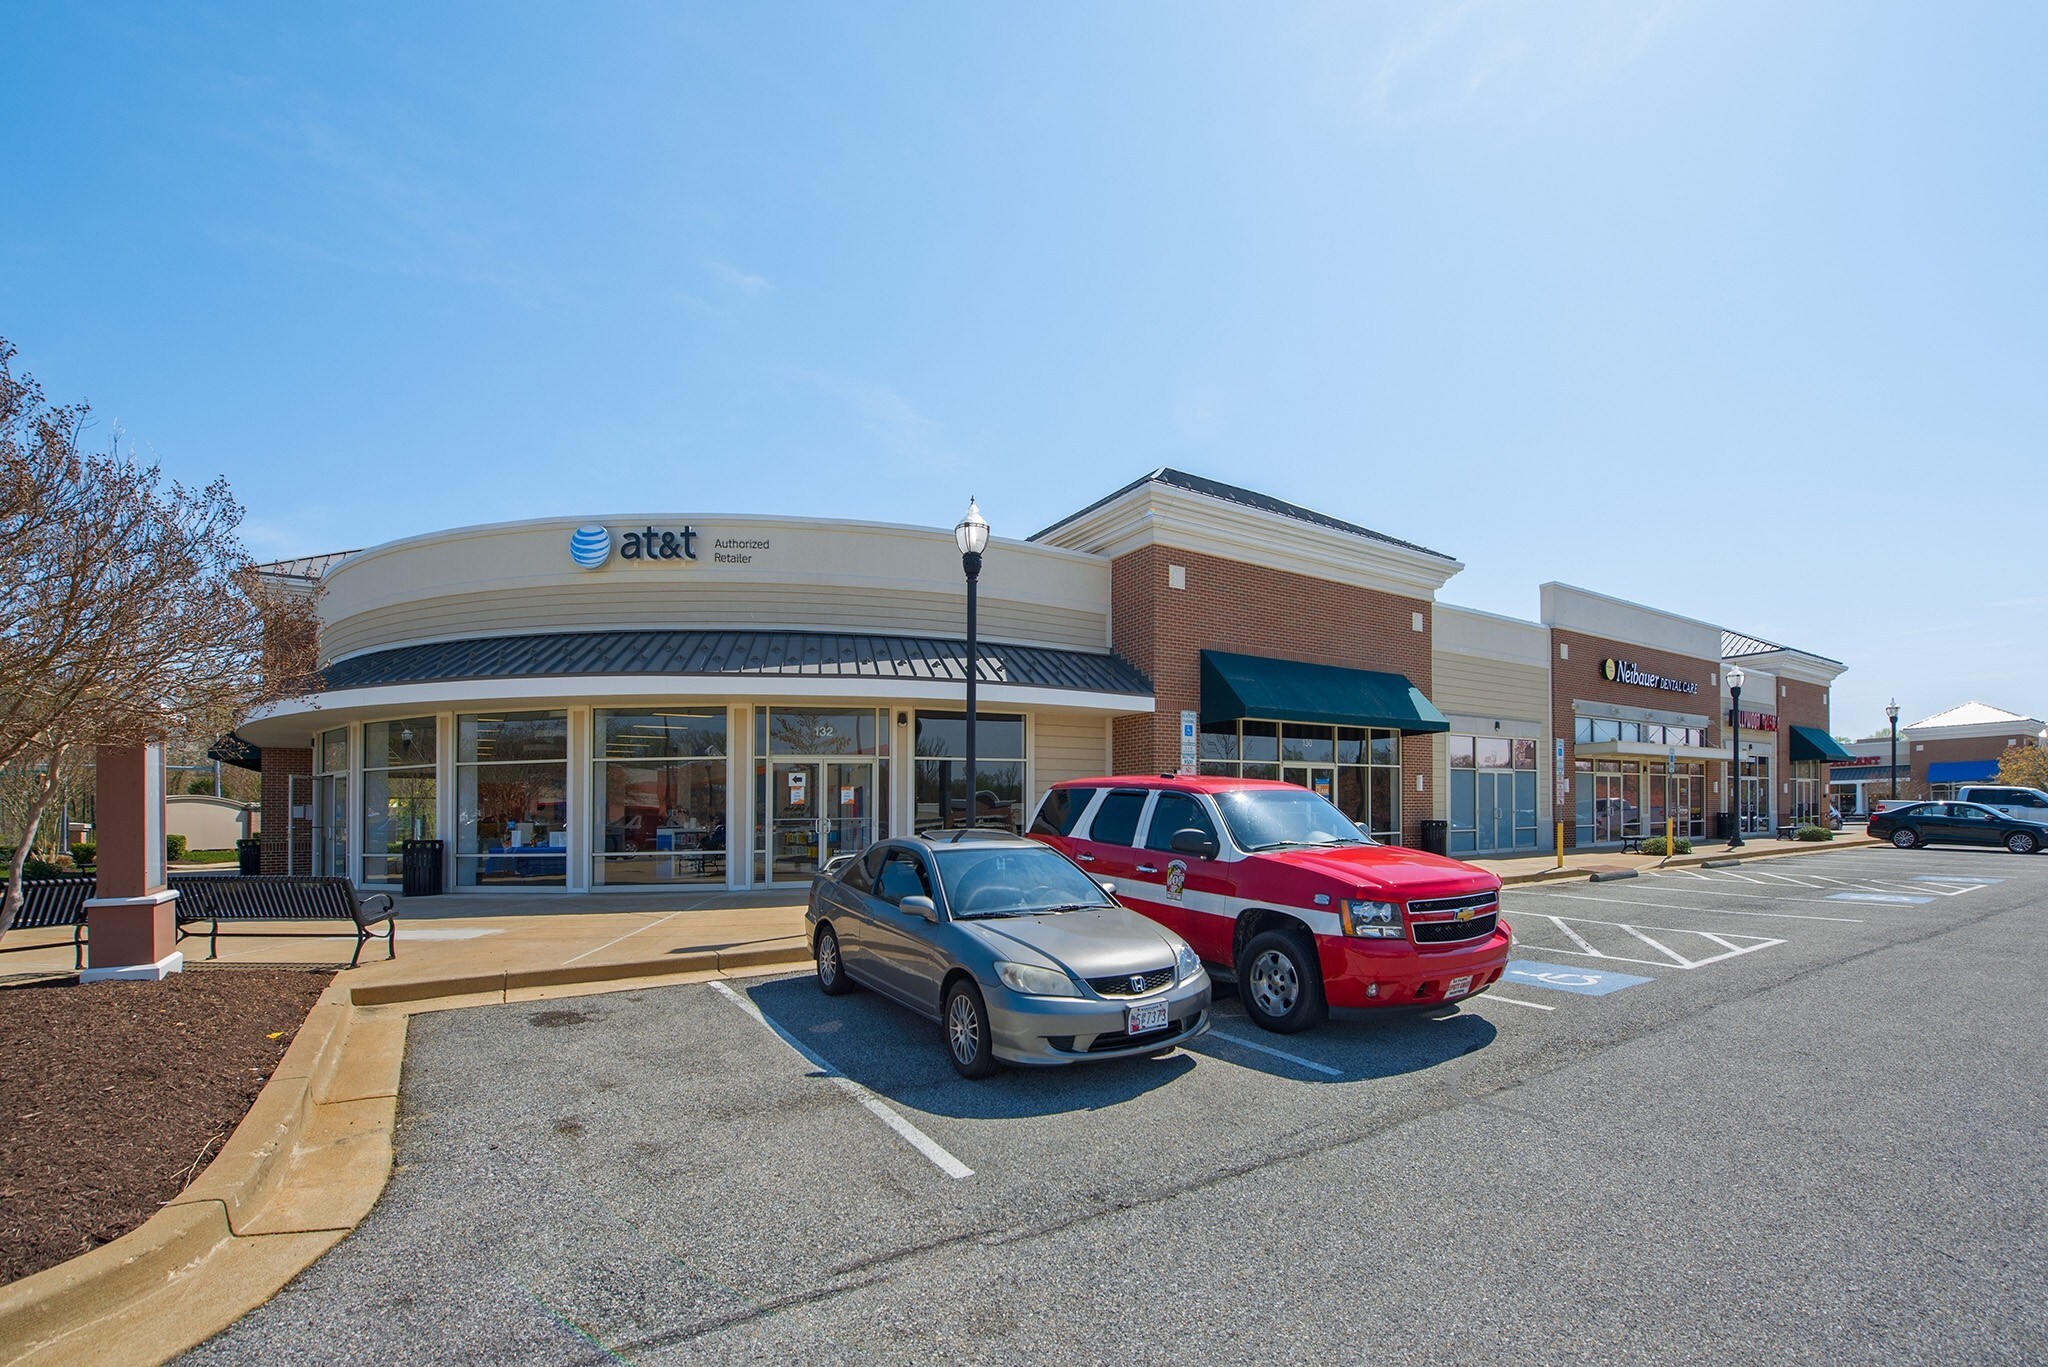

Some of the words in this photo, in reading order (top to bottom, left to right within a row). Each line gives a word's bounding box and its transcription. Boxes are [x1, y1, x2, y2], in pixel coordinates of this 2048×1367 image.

[620, 525, 698, 560] at&t
[714, 538, 770, 550] Authorized
[714, 552, 752, 564] Retailer
[1616, 660, 1660, 688] Neibauer
[1660, 677, 1682, 692] DENTAL
[1682, 681, 1698, 694] CARE
[815, 726, 834, 737] 132
